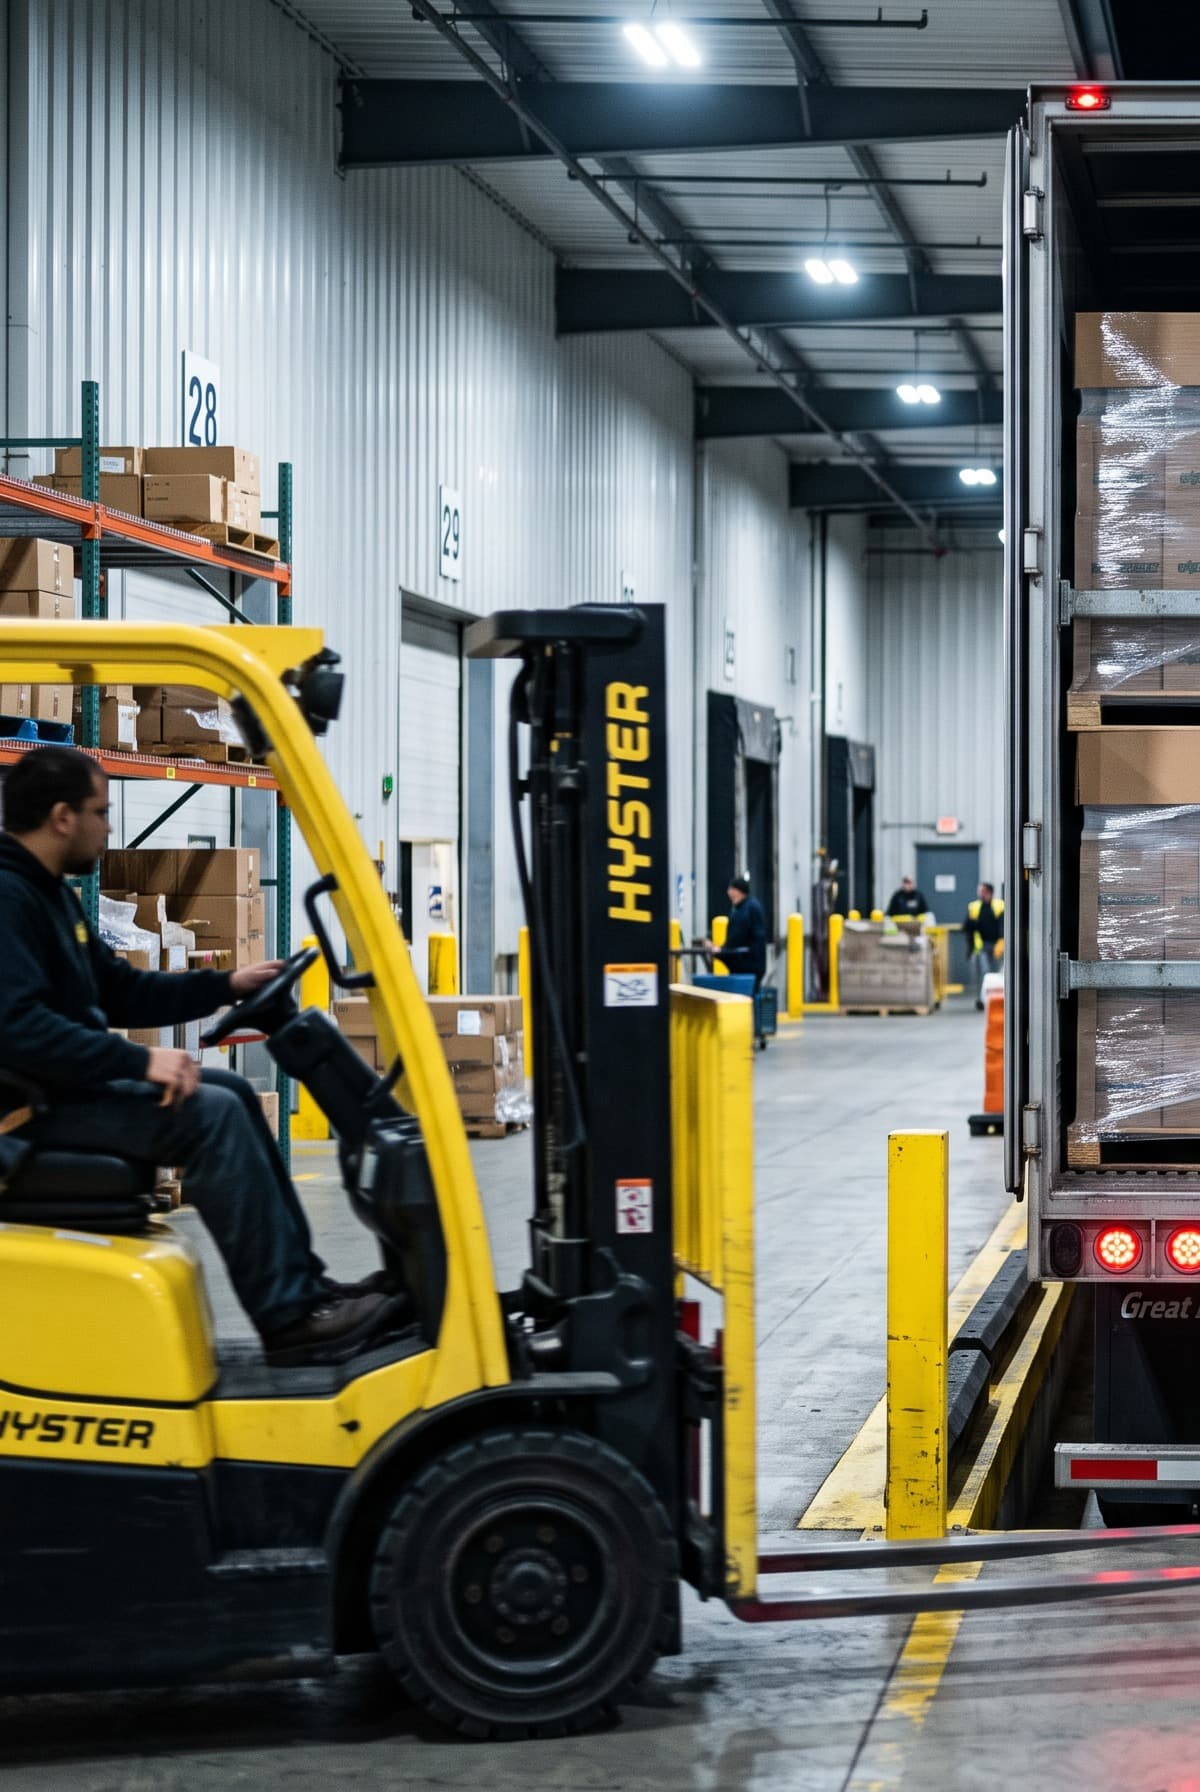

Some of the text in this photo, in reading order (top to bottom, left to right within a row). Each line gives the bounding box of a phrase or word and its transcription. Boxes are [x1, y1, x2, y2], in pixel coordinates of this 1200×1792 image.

[189, 375, 218, 447] 28
[443, 504, 460, 560] 29
[606, 681, 652, 922] HYSTER
[1121, 1291, 1193, 1319] Great
